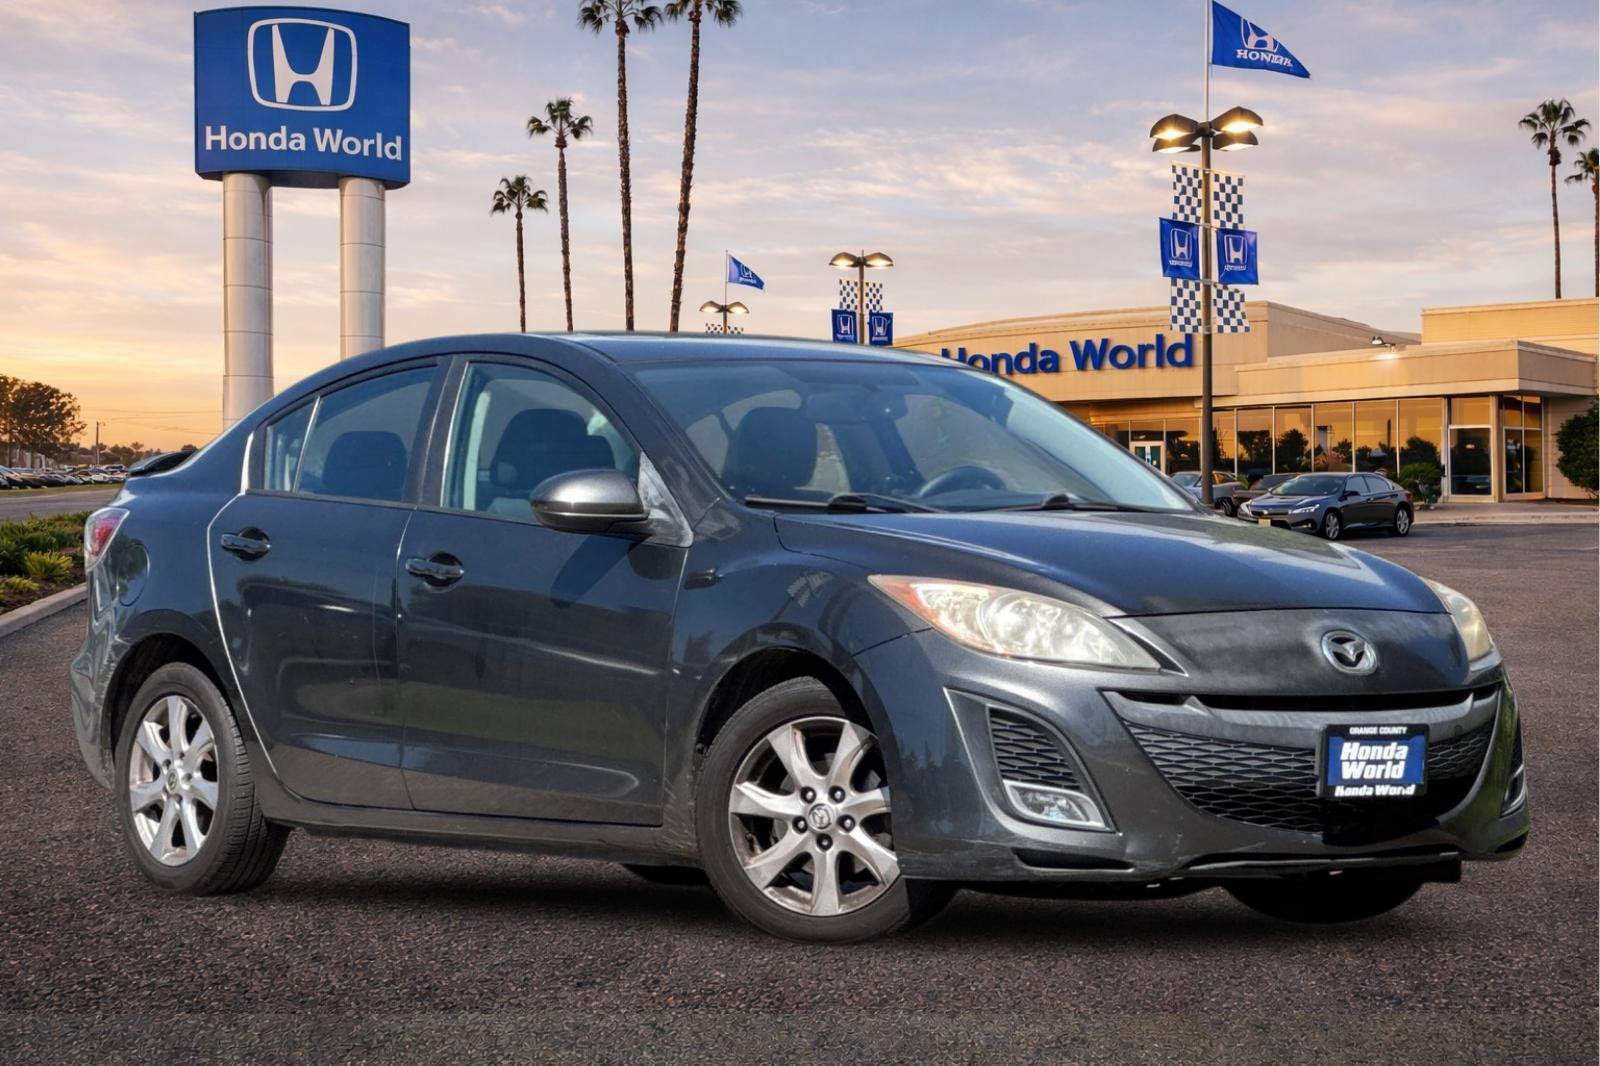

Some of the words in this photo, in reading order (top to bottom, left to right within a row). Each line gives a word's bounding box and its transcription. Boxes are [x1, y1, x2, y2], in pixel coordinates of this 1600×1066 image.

[205, 125, 306, 152] Honda
[312, 127, 402, 161] World
[1069, 333, 1194, 372] World
[1349, 726, 1378, 735] ORANGE
[1379, 726, 1408, 735] COUNTY
[1340, 741, 1409, 761] Honda
[1341, 761, 1406, 780] World
